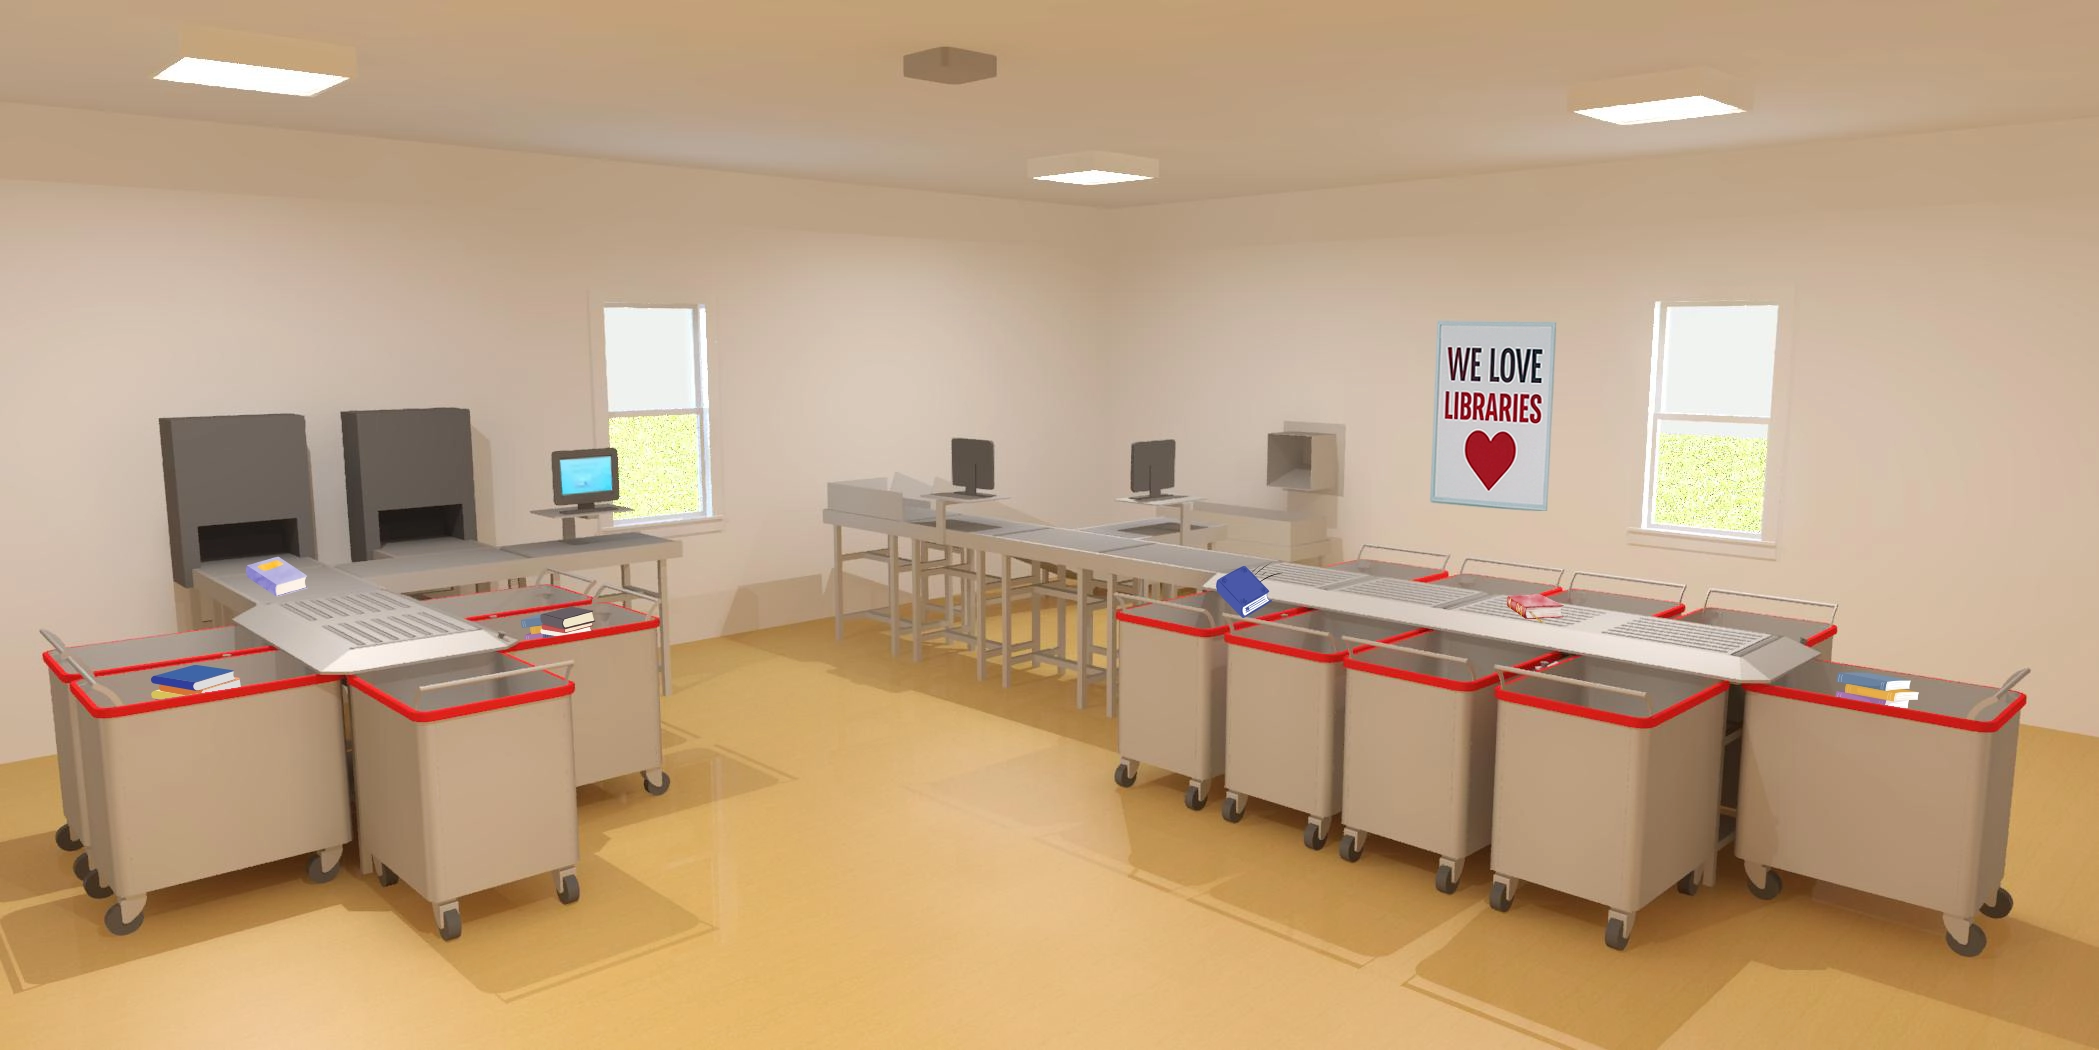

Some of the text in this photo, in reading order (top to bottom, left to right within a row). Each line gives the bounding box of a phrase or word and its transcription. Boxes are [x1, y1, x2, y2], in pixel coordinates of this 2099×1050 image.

[1447, 346, 1543, 383] WE LOVE
[1444, 390, 1543, 424] LIBRARIES
